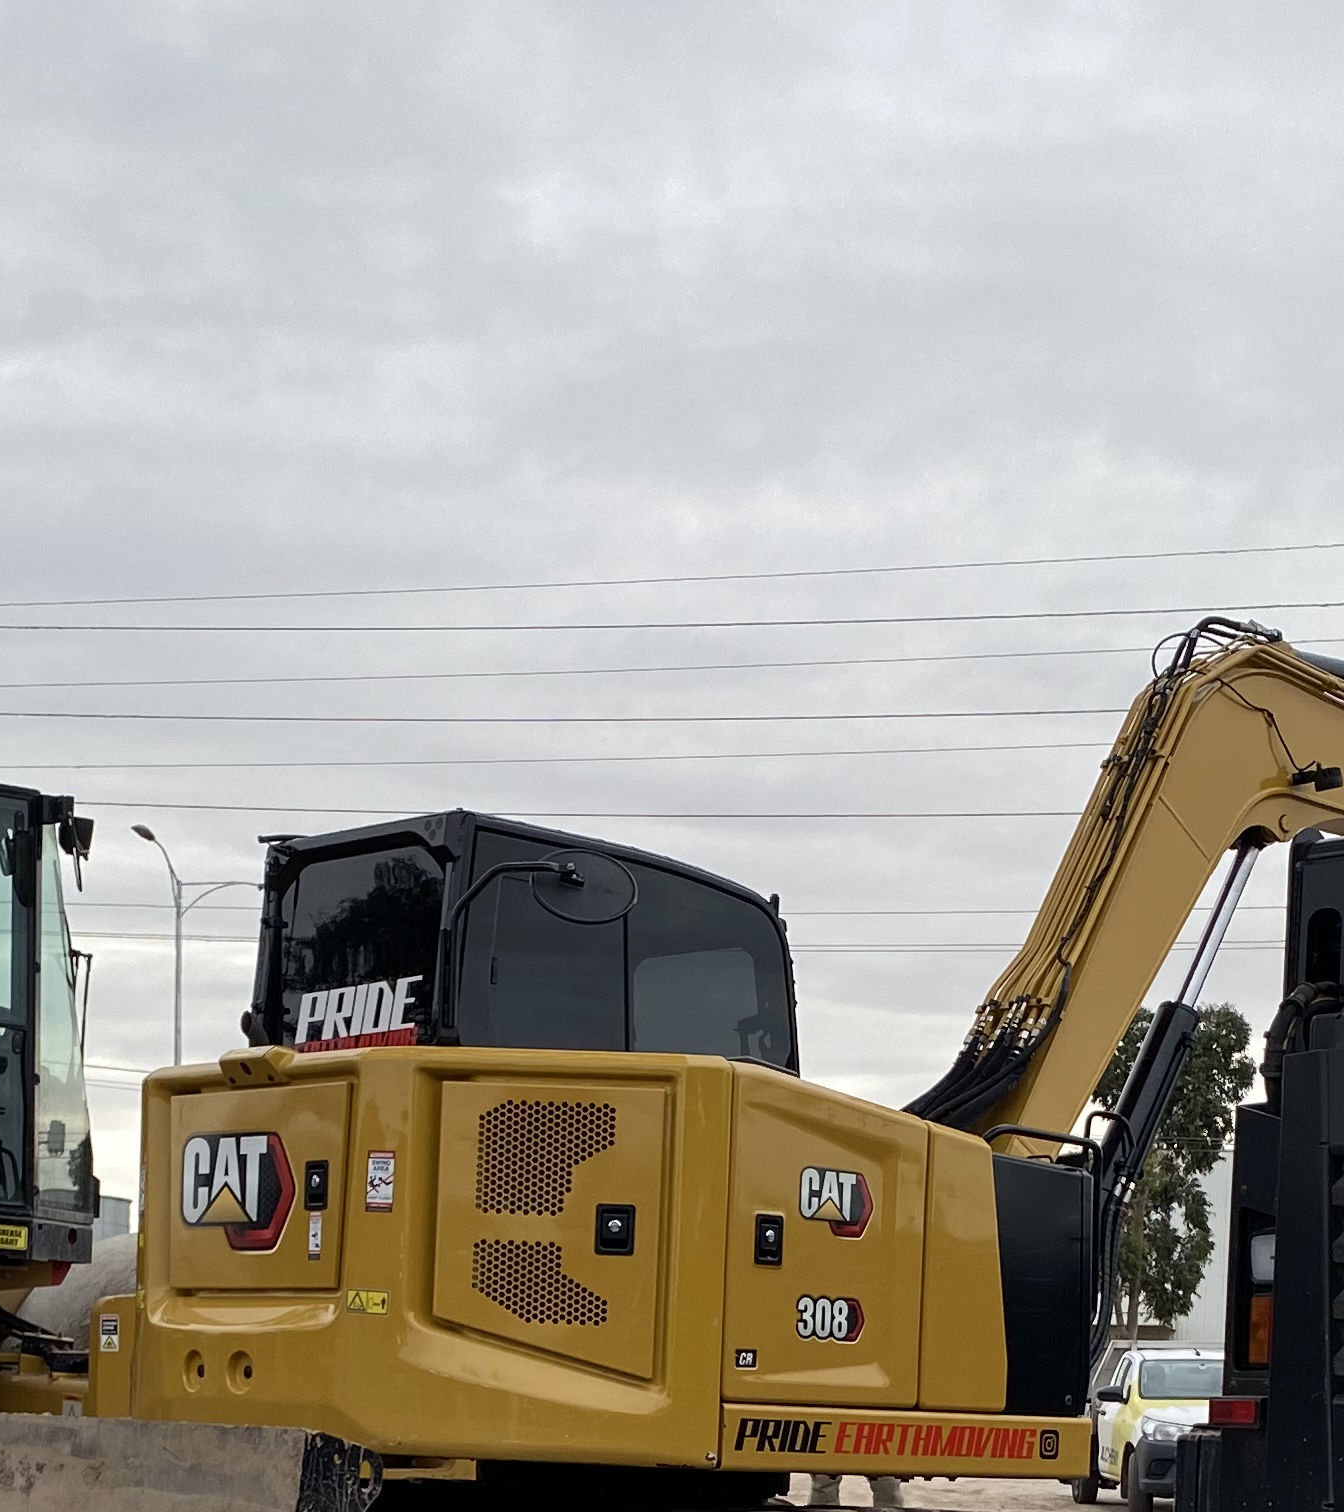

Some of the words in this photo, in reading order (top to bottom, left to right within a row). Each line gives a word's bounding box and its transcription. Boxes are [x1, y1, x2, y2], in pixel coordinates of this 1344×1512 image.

[294, 974, 424, 1045] PRIDE
[182, 1135, 268, 1223] CAT
[800, 1167, 856, 1222] CAT
[797, 1297, 849, 1339] 308
[739, 1352, 754, 1366] CR
[734, 1418, 832, 1455] PRIDE
[833, 1421, 1038, 1459] EARTHMOVING
